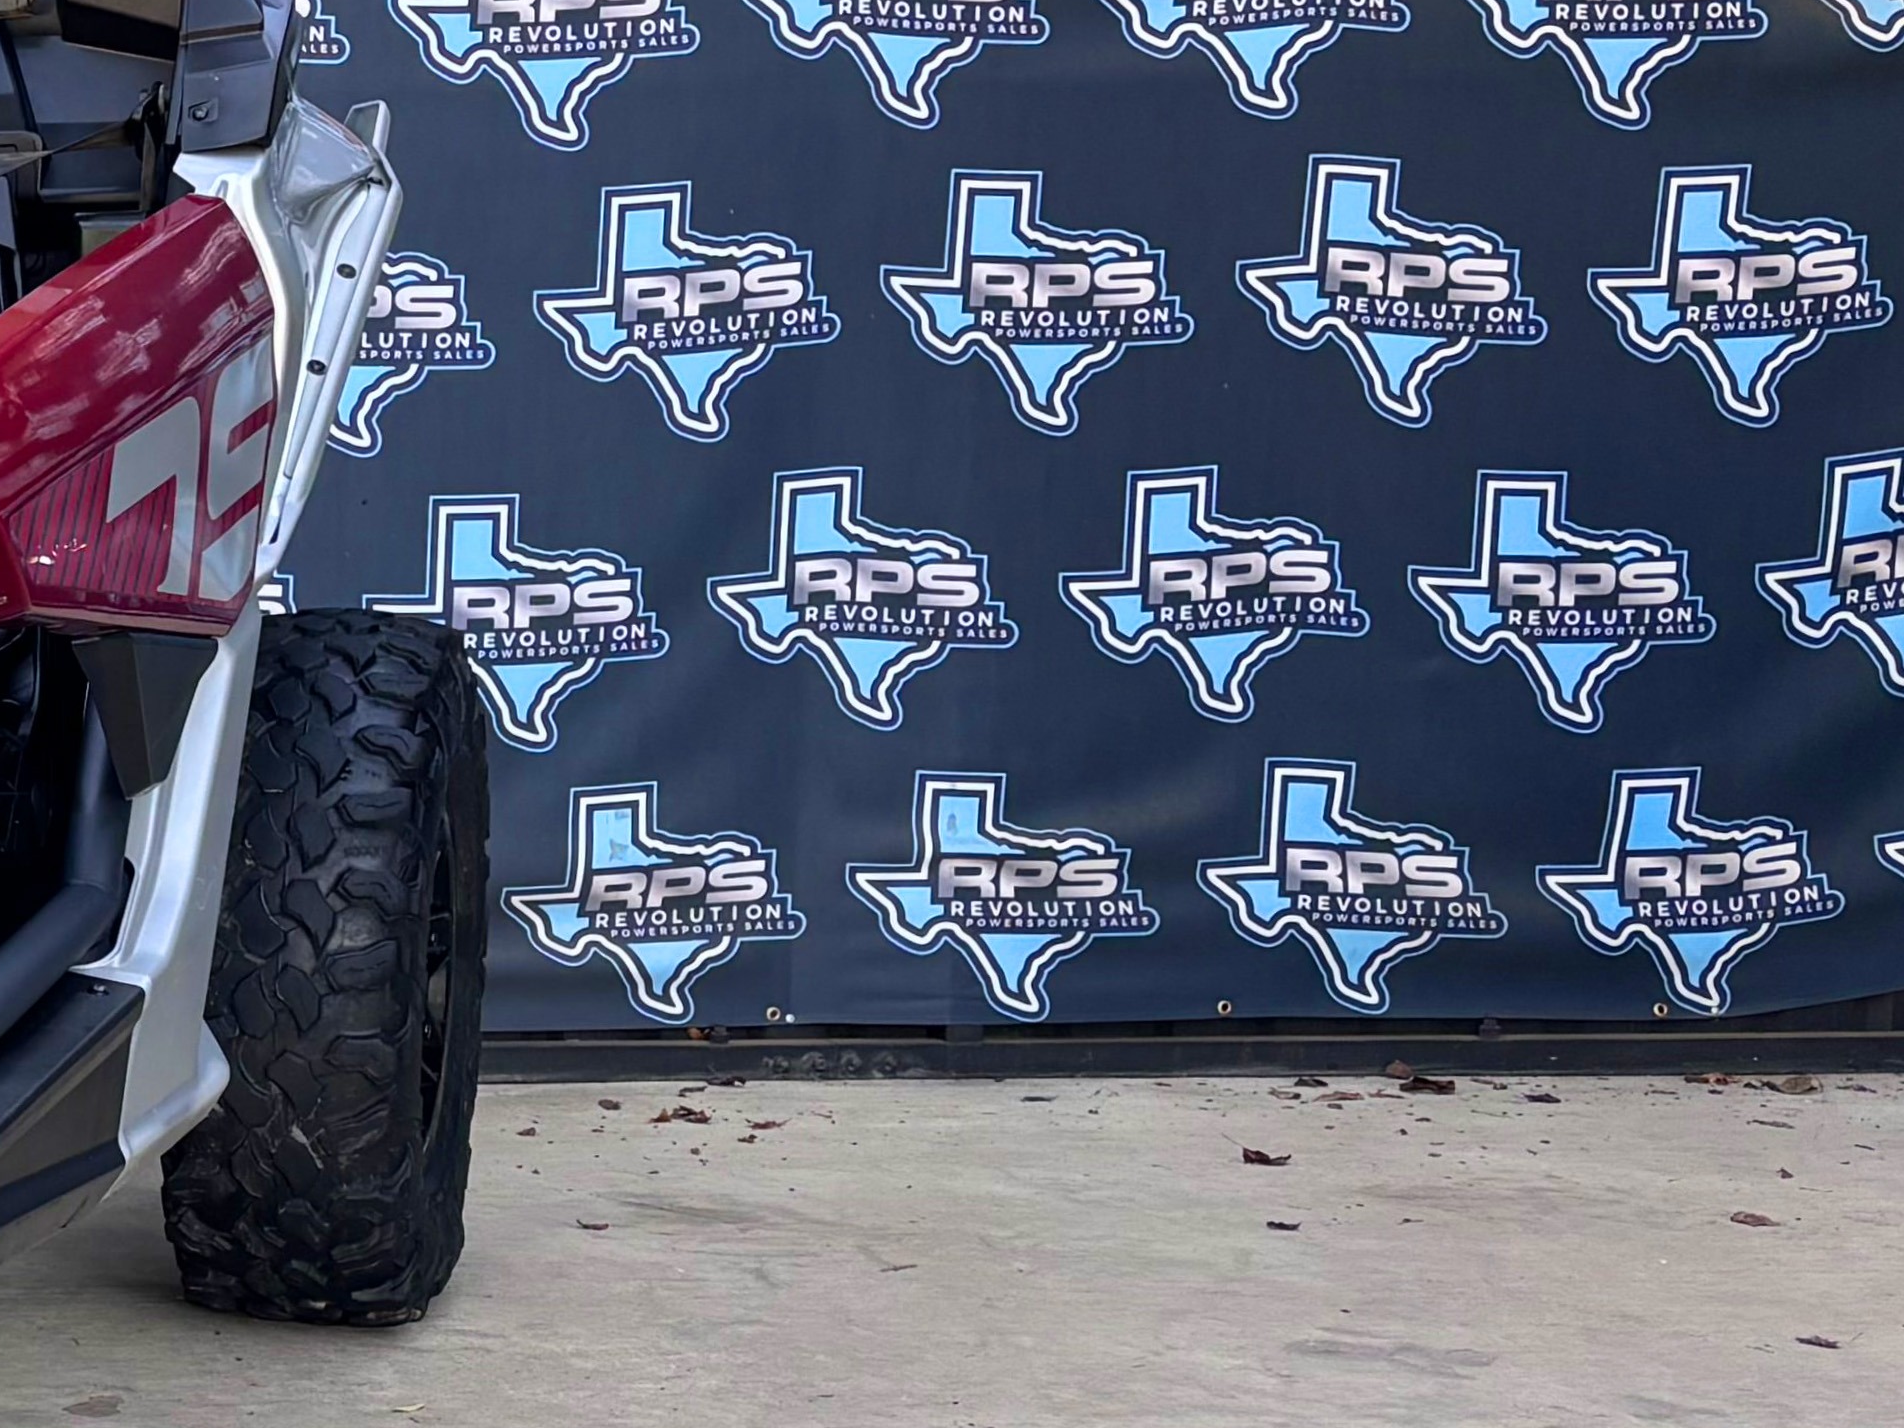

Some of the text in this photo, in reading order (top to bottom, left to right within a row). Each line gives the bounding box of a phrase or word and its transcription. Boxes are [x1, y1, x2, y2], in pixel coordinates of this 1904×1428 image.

[1556, 2, 1740, 20] REVOLUTION
[489, 18, 674, 43] REVOLUTION
[854, 16, 1038, 34] POWERSPORTS SALES
[1570, 19, 1756, 32] POWERSPORTS SALES
[504, 35, 688, 53] POWERSPORTS SALES
[970, 261, 1155, 308] RPS
[1326, 248, 1510, 302] RPS
[1676, 247, 1857, 302] RPS
[623, 262, 803, 321] RPS
[981, 307, 1168, 326] REVOLUTION
[1336, 296, 1522, 322] REVOLUTION
[1686, 292, 1870, 321] REVOLUTION
[634, 308, 816, 340] REVOLUTION
[996, 324, 1182, 338] POWERSPORTS SALES
[1350, 314, 1536, 334] POWERSPORTS SALES
[1700, 307, 1882, 332] POWERSPORTS SALES
[795, 558, 979, 606] RPS
[1150, 550, 1330, 604] RPS
[1498, 561, 1678, 606] RPS
[453, 579, 633, 629] RPS
[805, 605, 993, 626] REVOLUTION
[1161, 597, 1345, 622] REVOLUTION
[1509, 607, 1692, 625] REVOLUTION
[464, 624, 645, 648] REVOLUTION
[820, 622, 1006, 638] POWERSPORTS SALES
[1523, 624, 1705, 636] POWERSPORTS SALES
[478, 640, 658, 658] POWERSPORTS SALES
[938, 859, 1119, 898] RPS
[1286, 848, 1462, 897] RPS
[1625, 842, 1800, 898] RPS
[951, 900, 1133, 916] REVOLUTION
[1298, 895, 1481, 917] REVOLUTION
[1638, 885, 1818, 917] REVOLUTION
[1655, 900, 1833, 927] POWERSPORTS SALES
[966, 917, 1148, 927] POWERSPORTS SALES
